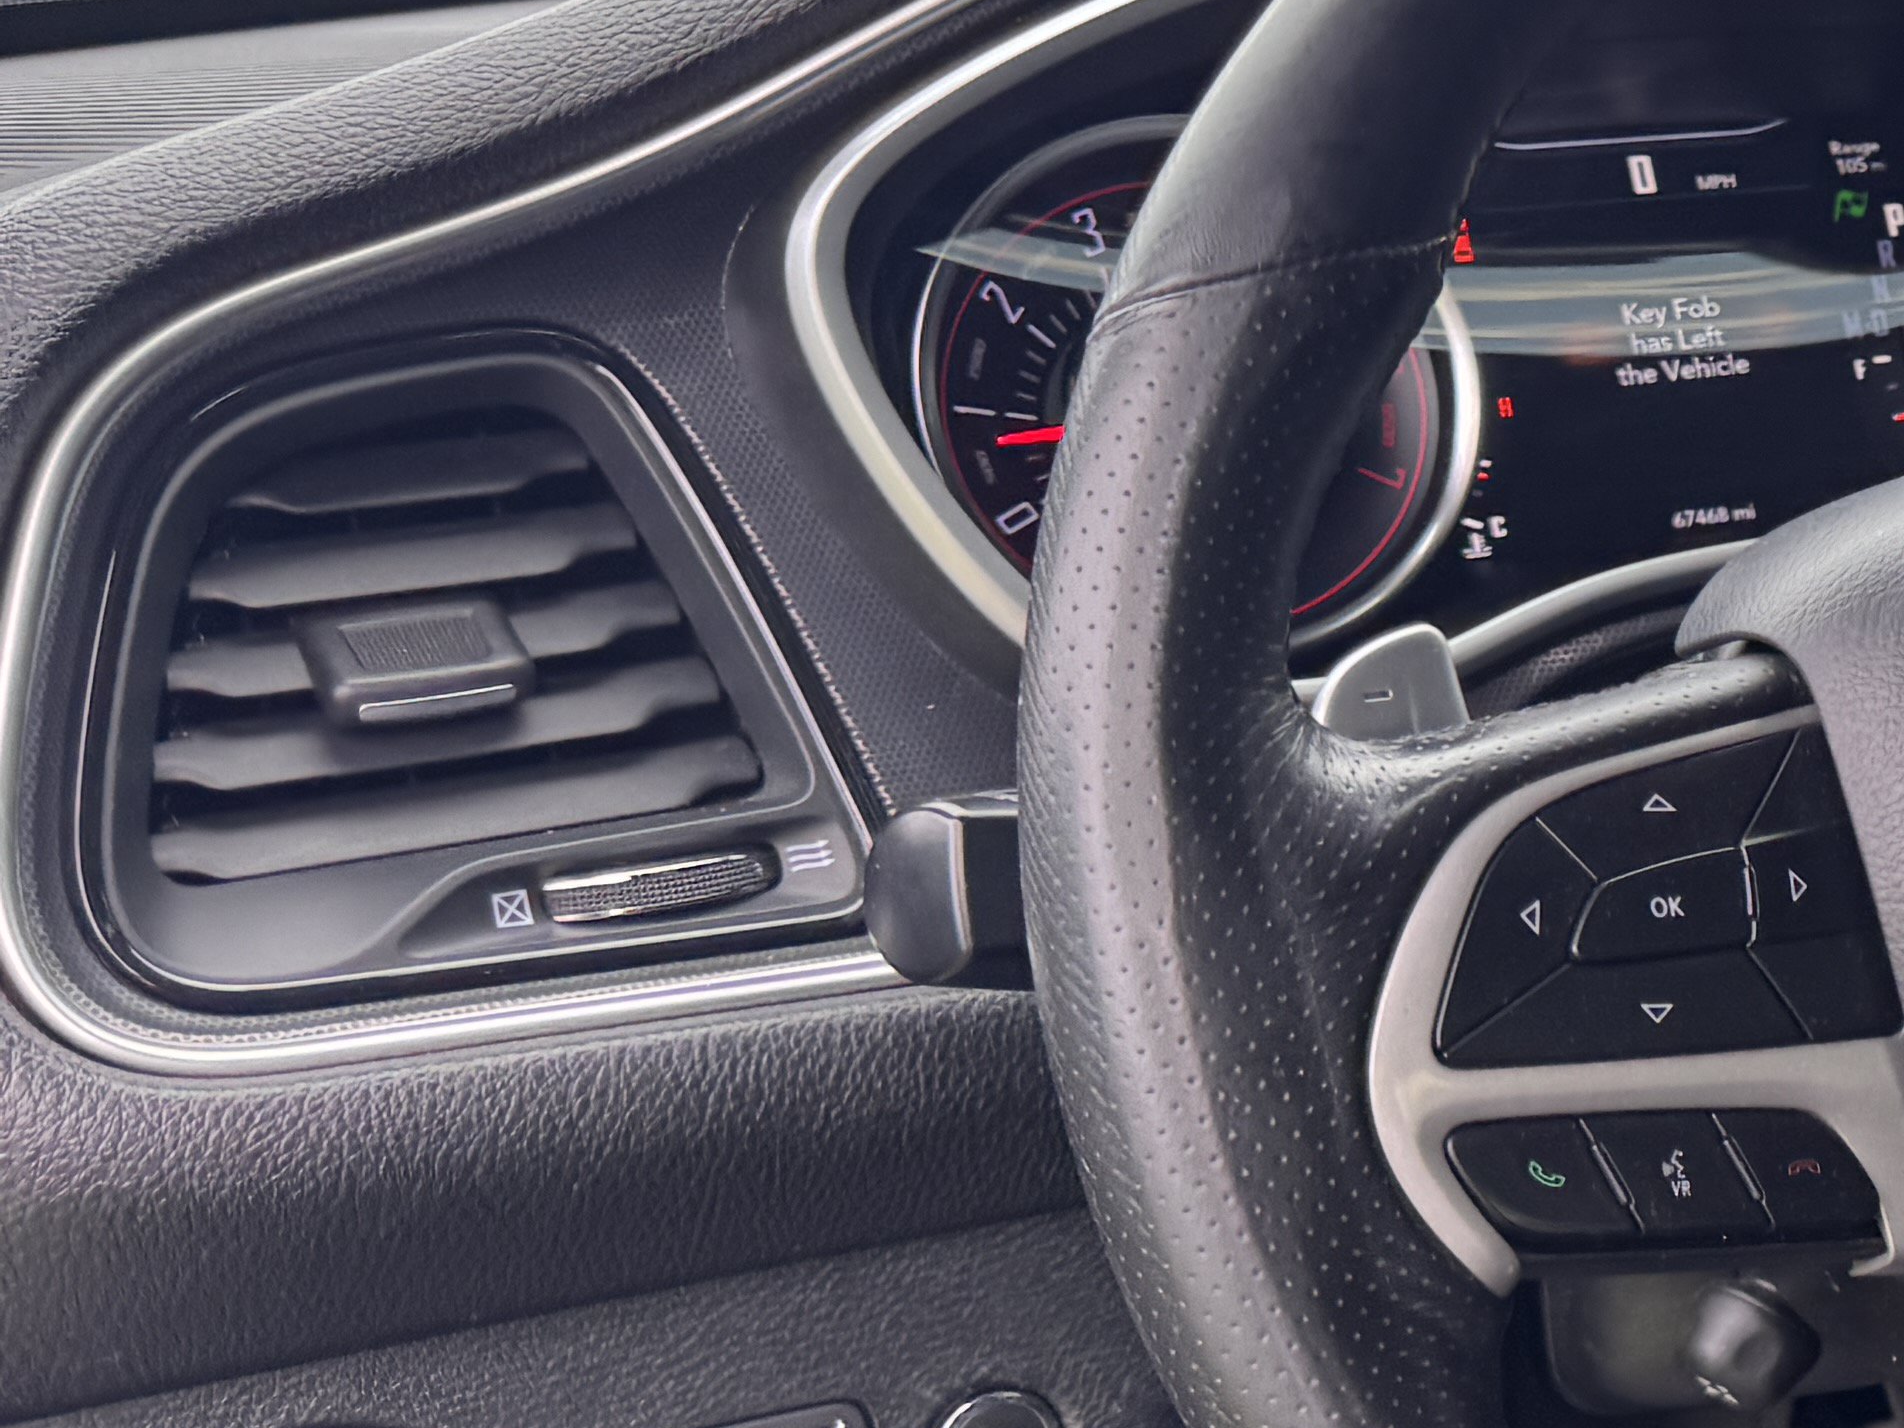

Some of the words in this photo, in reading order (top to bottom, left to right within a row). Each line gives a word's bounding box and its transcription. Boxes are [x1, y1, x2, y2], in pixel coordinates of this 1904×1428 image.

[1828, 140, 1880, 157] Range
[1627, 154, 1658, 195] 0
[1695, 173, 1737, 191] MPH
[1071, 208, 1106, 258] 3
[1876, 240, 1896, 269] R
[979, 280, 1025, 324] 2
[1620, 302, 1667, 329] Key
[1671, 295, 1721, 321] Fob
[1630, 331, 1673, 355] has
[1677, 325, 1727, 352] Left
[1615, 361, 1659, 387] the
[1659, 354, 1751, 383] Vehicle
[996, 502, 1040, 535] 0
[1650, 896, 1685, 919] OK
[1671, 1180, 1692, 1198] VR
